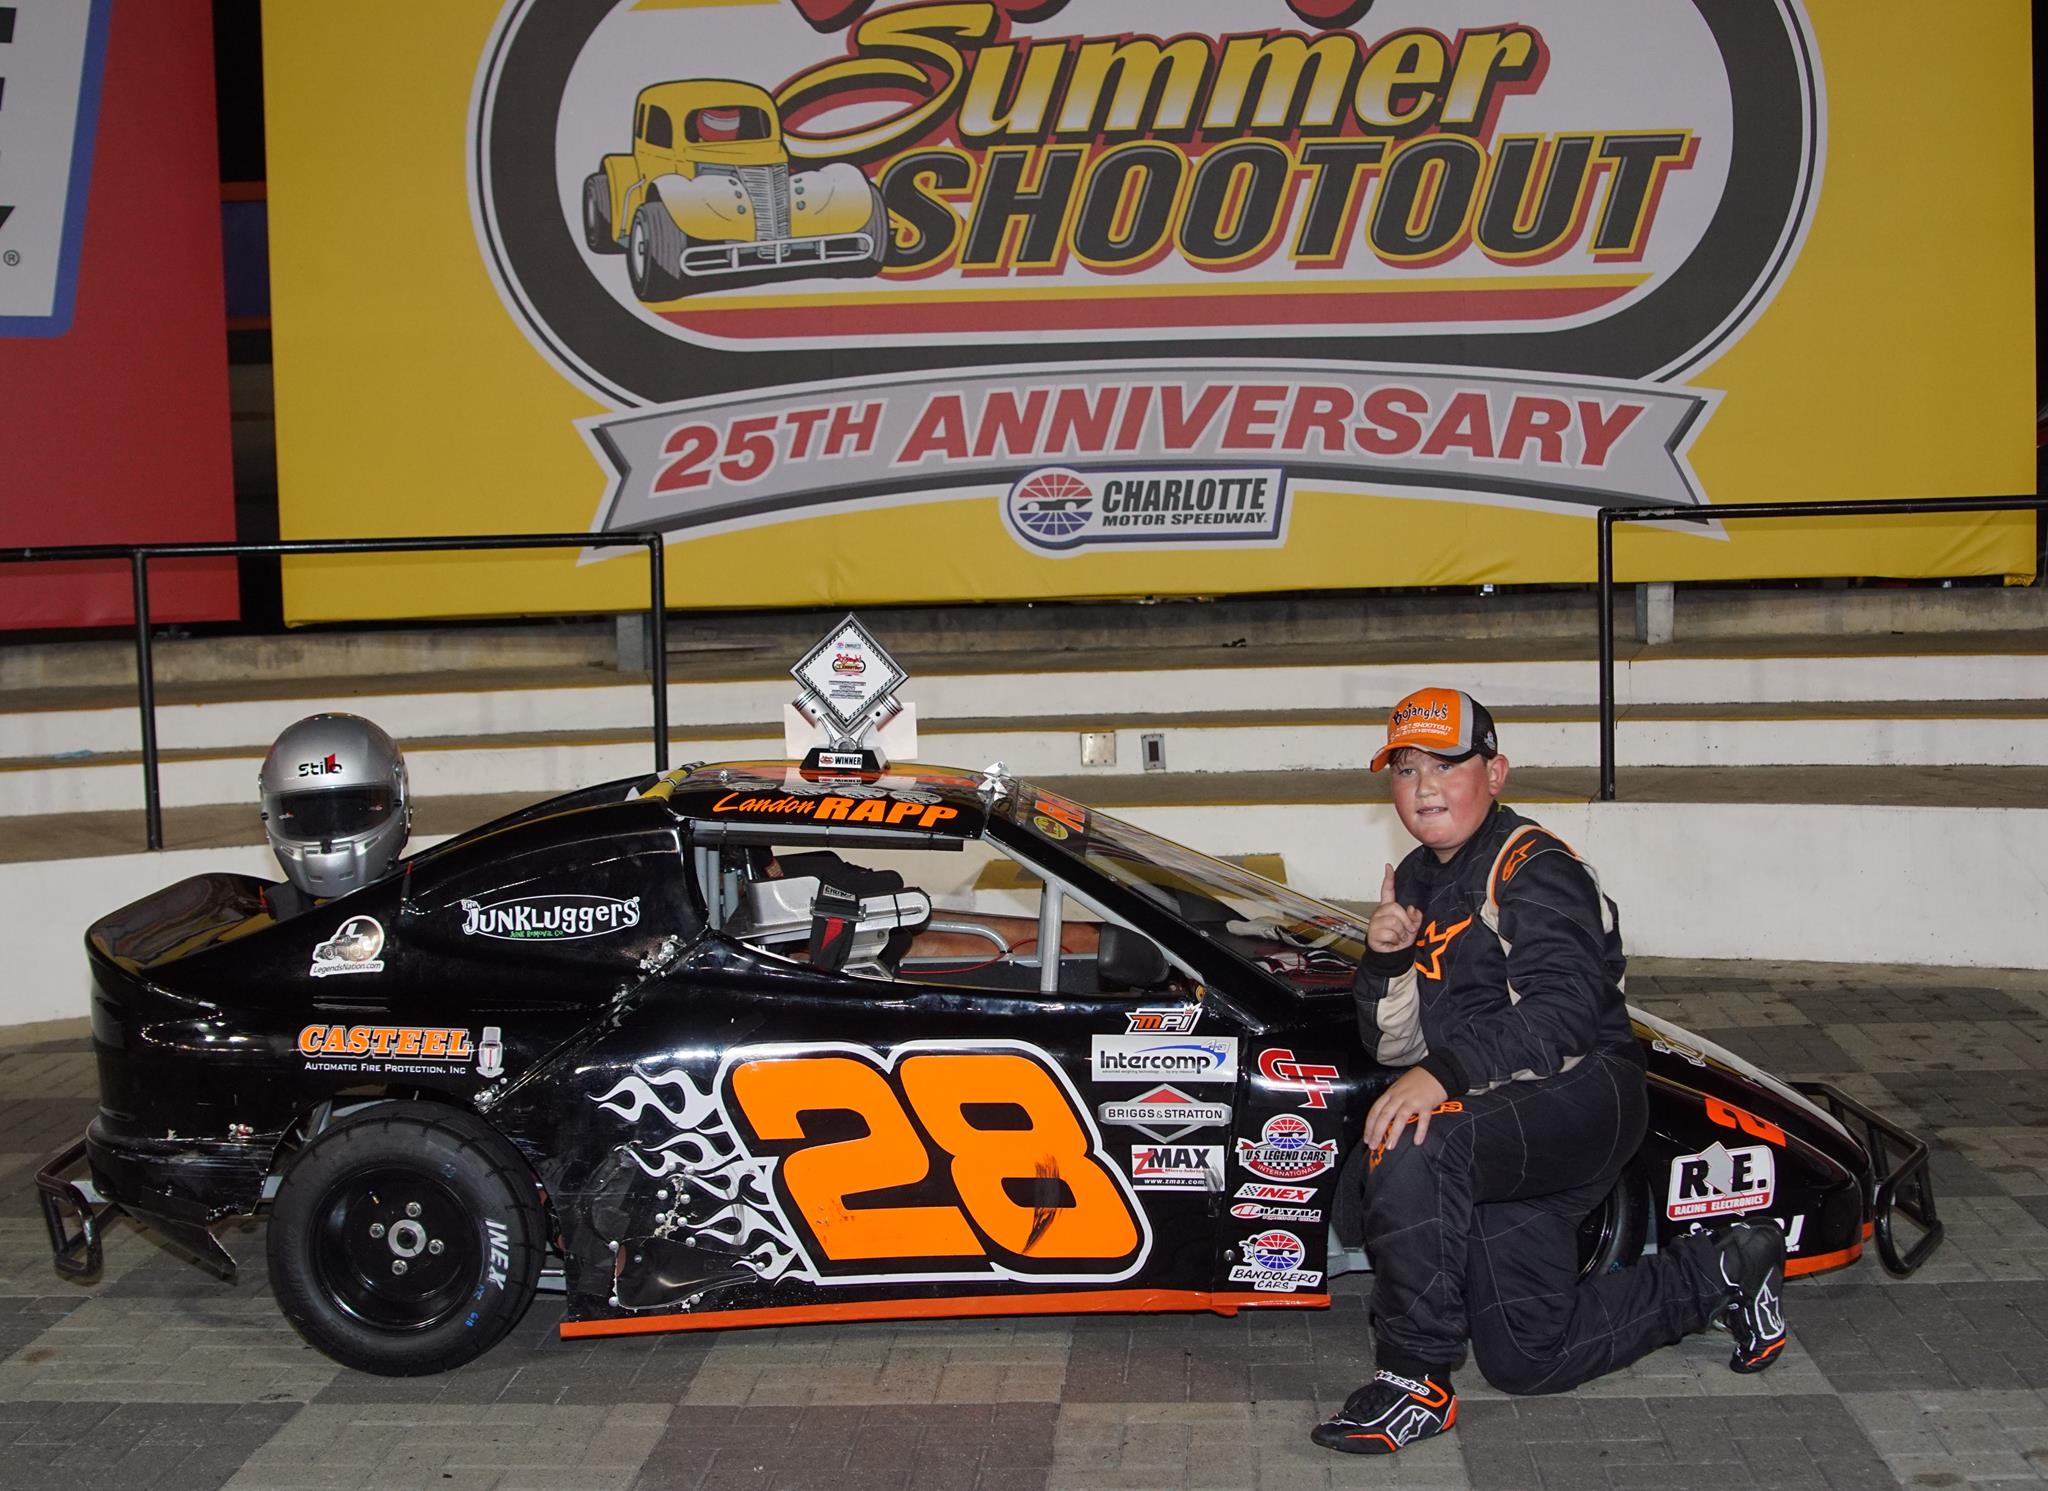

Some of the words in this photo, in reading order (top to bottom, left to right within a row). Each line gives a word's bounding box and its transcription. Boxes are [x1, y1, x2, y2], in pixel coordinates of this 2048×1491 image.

[777, 2, 1540, 158] Summer
[882, 130, 1692, 273] SHOOTOUT
[653, 403, 883, 493] 25TH
[897, 384, 1645, 467] ANNIVERSARY
[1102, 478, 1268, 513] CHARLOTTE
[1102, 513, 1166, 527] MOTOR
[834, 755, 862, 766] WINNER
[712, 791, 816, 815] Landon
[813, 796, 959, 828] RAPP
[299, 1025, 471, 1059] CASTEEL
[1100, 1050, 1211, 1074] Intercomp
[728, 1052, 1142, 1264] 28
[1264, 1150, 1299, 1161] LEGEND
[1300, 1151, 1327, 1162] CARS
[1258, 1165, 1317, 1177] INTERNATIONAL
[1256, 1187, 1311, 1201] INEX
[1674, 1203, 1707, 1216] RACING
[1711, 1195, 1764, 1211] ELECTRONICS
[485, 1220, 509, 1291] INEX
[1233, 1269, 1318, 1284] BANDOLERO
[1257, 1280, 1289, 1290] CARS
